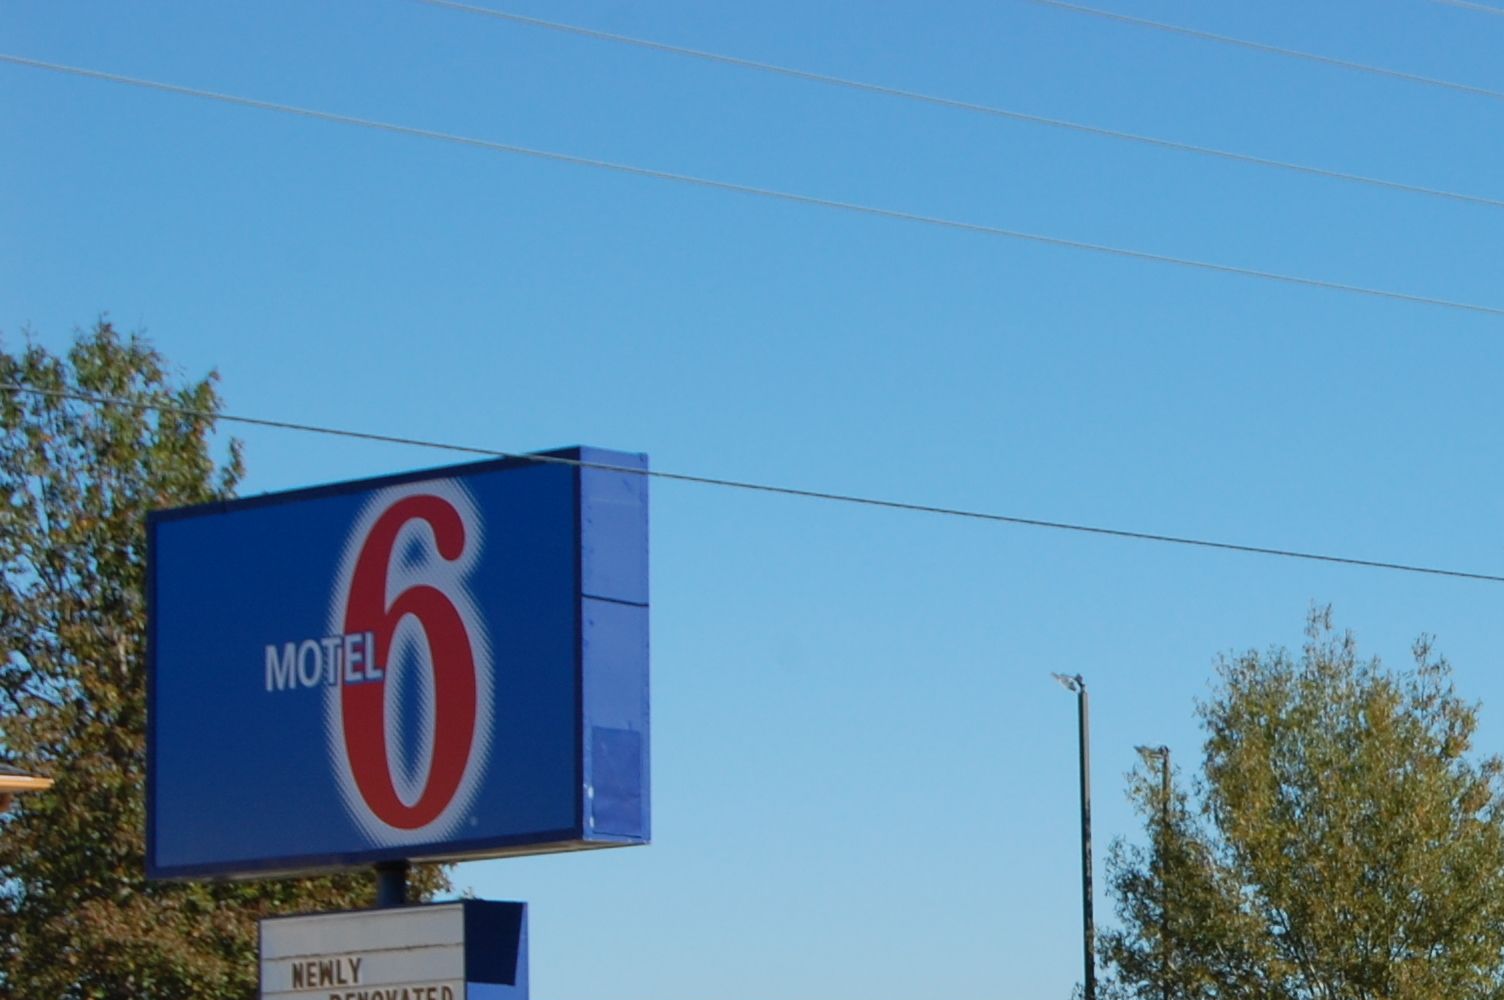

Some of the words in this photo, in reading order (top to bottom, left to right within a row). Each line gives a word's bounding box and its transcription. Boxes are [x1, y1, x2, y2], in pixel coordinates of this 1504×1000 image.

[265, 632, 384, 691] MOTEL
[340, 493, 477, 830] 6
[292, 957, 362, 989] NEWLY
